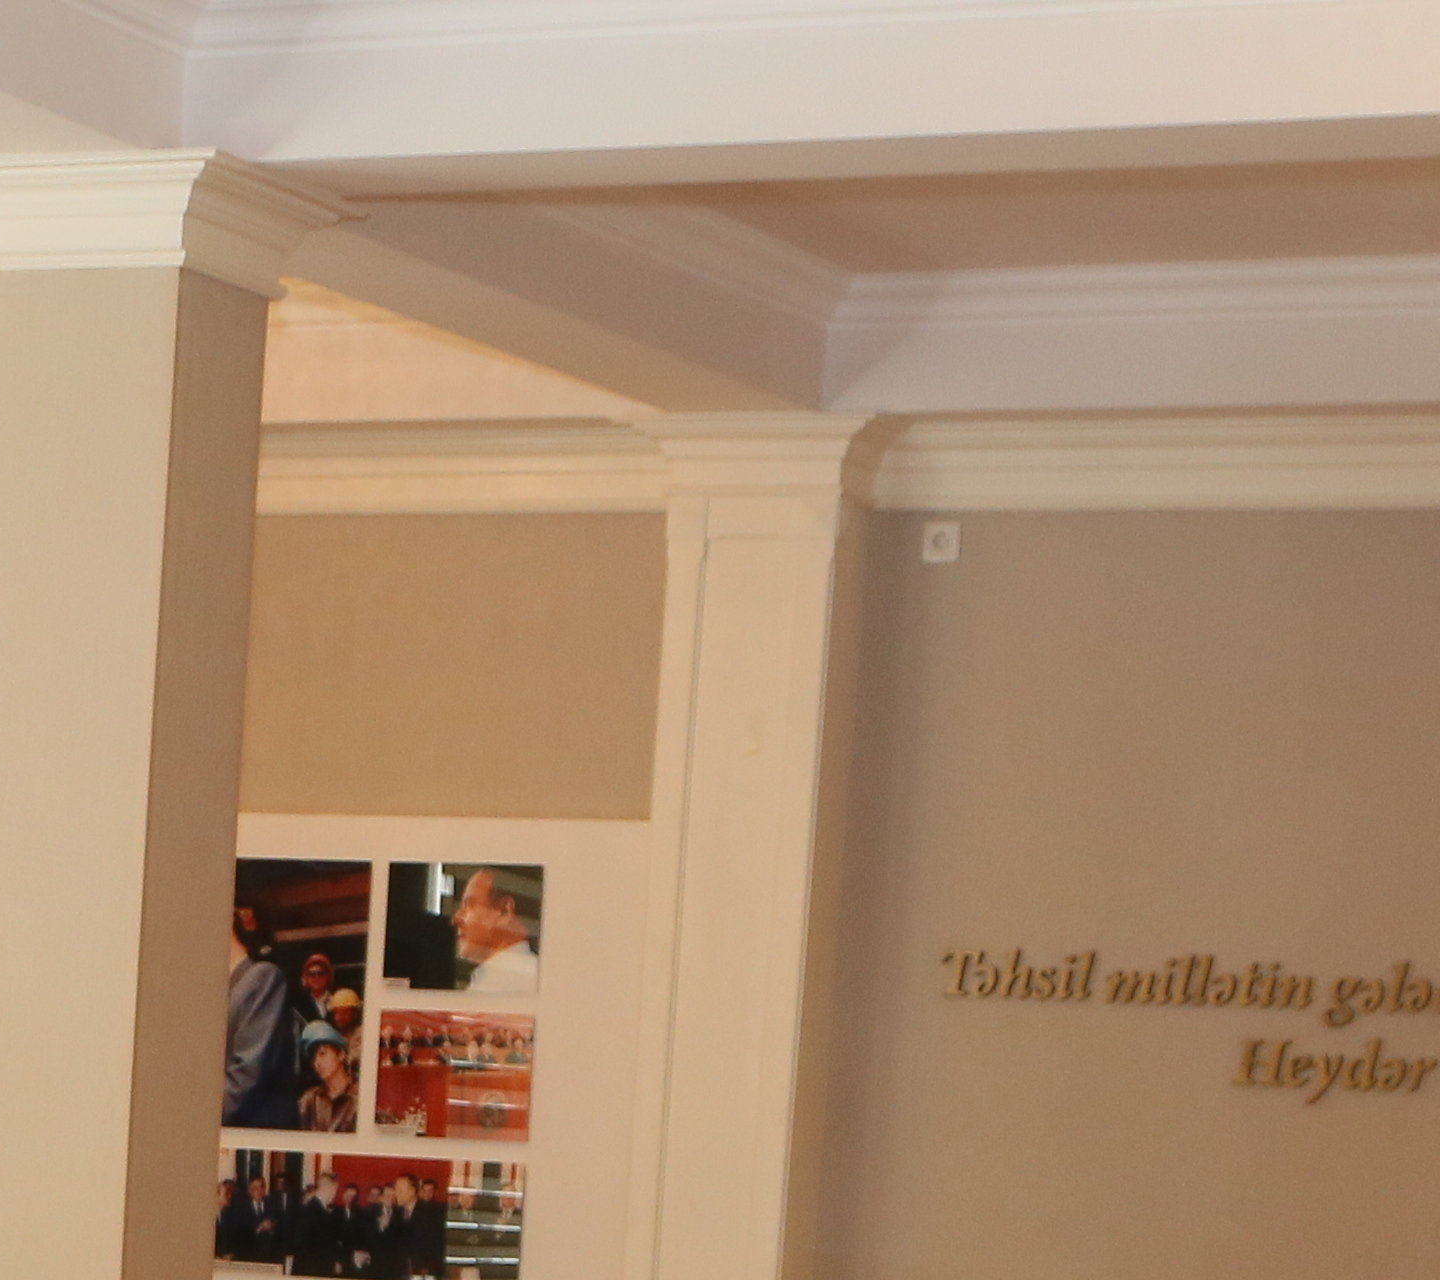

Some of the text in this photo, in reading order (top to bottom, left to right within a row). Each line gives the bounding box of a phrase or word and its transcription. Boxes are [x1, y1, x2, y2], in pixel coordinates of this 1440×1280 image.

[941, 948, 1097, 1002] Təhsil
[1106, 953, 1315, 1010] millətin
[1231, 1037, 1438, 1107] Heydər
